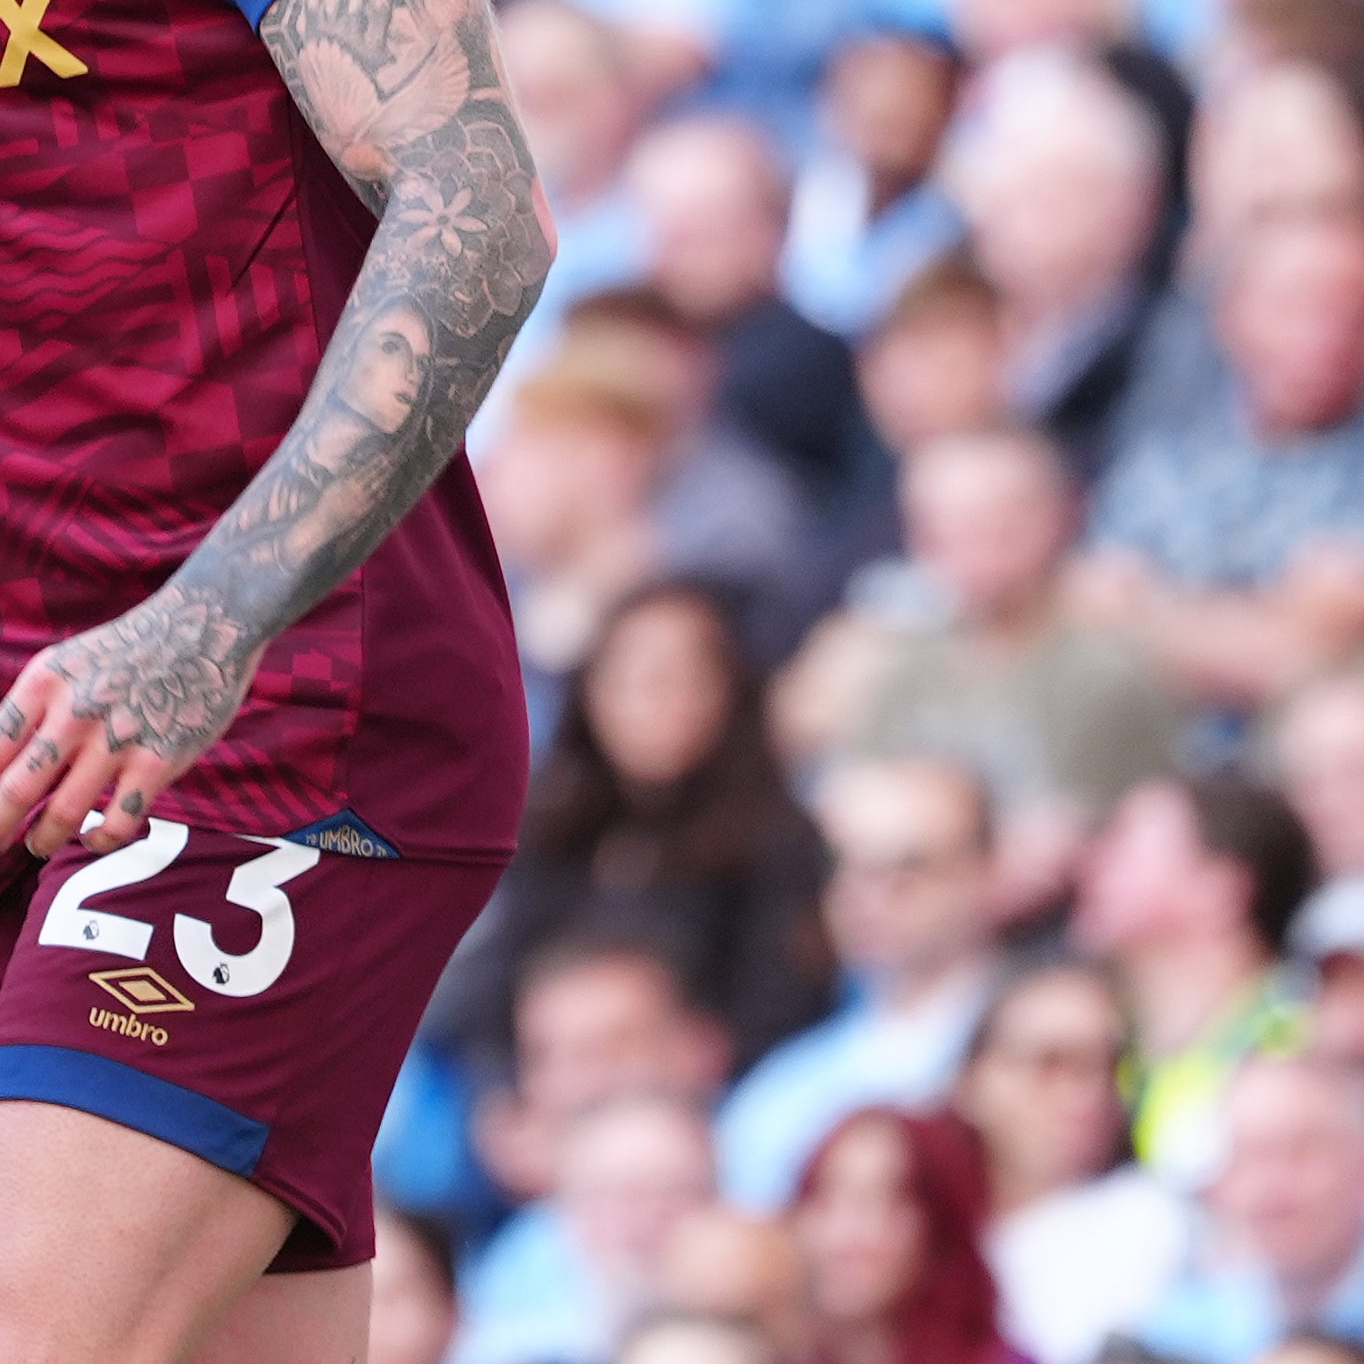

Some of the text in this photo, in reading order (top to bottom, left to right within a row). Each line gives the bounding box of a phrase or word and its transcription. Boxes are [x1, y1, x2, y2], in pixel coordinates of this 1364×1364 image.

[319, 825, 373, 857] UMBRO
[38, 809, 321, 998] 23
[88, 1006, 168, 1046] umbro
